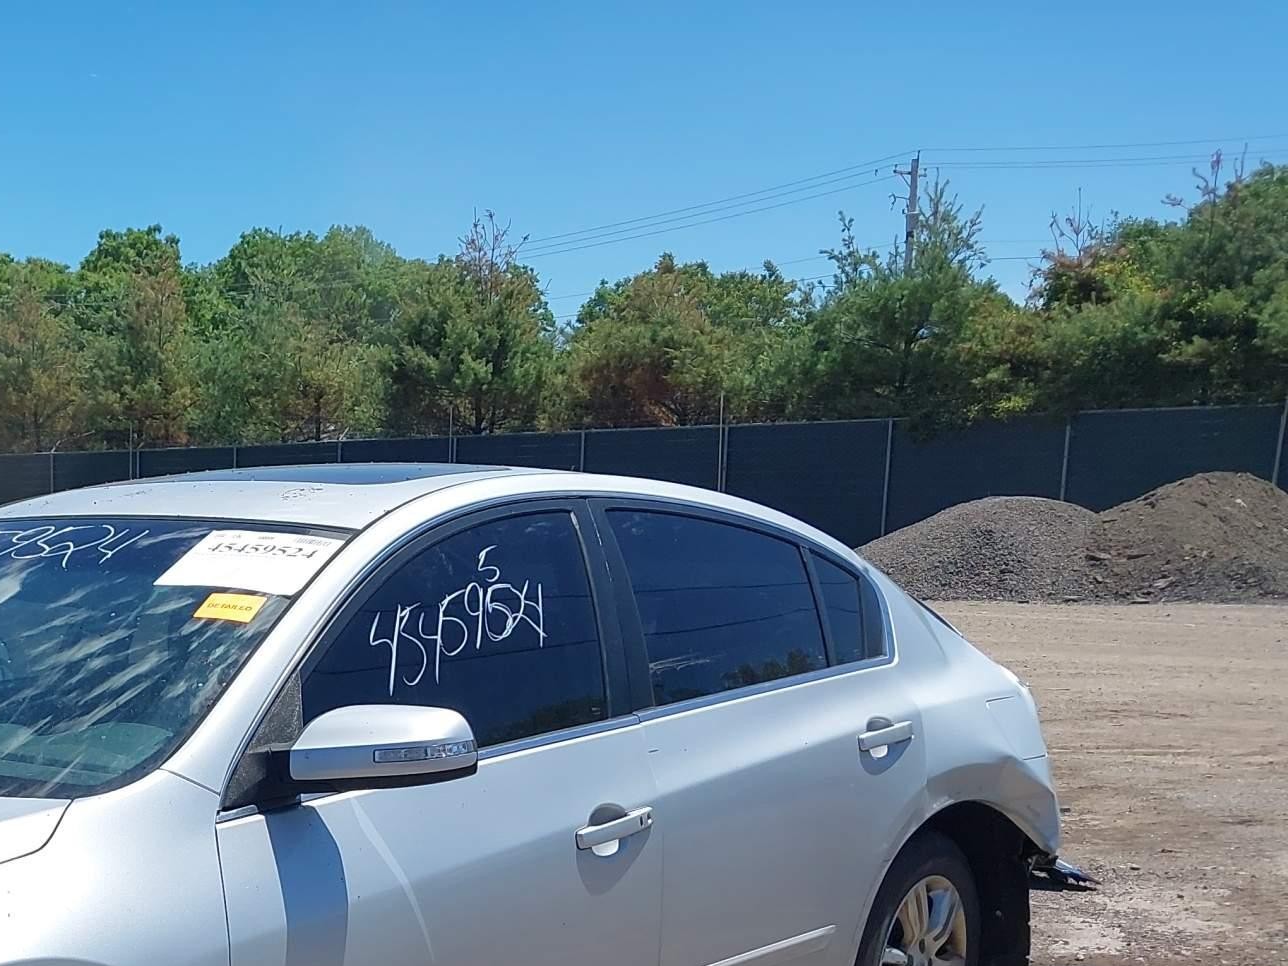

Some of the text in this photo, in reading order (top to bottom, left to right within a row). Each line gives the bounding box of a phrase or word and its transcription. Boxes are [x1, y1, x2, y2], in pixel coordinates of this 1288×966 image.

[208, 543, 318, 559] 45459524
[478, 545, 500, 582] 5
[207, 603, 253, 612] DETAILED
